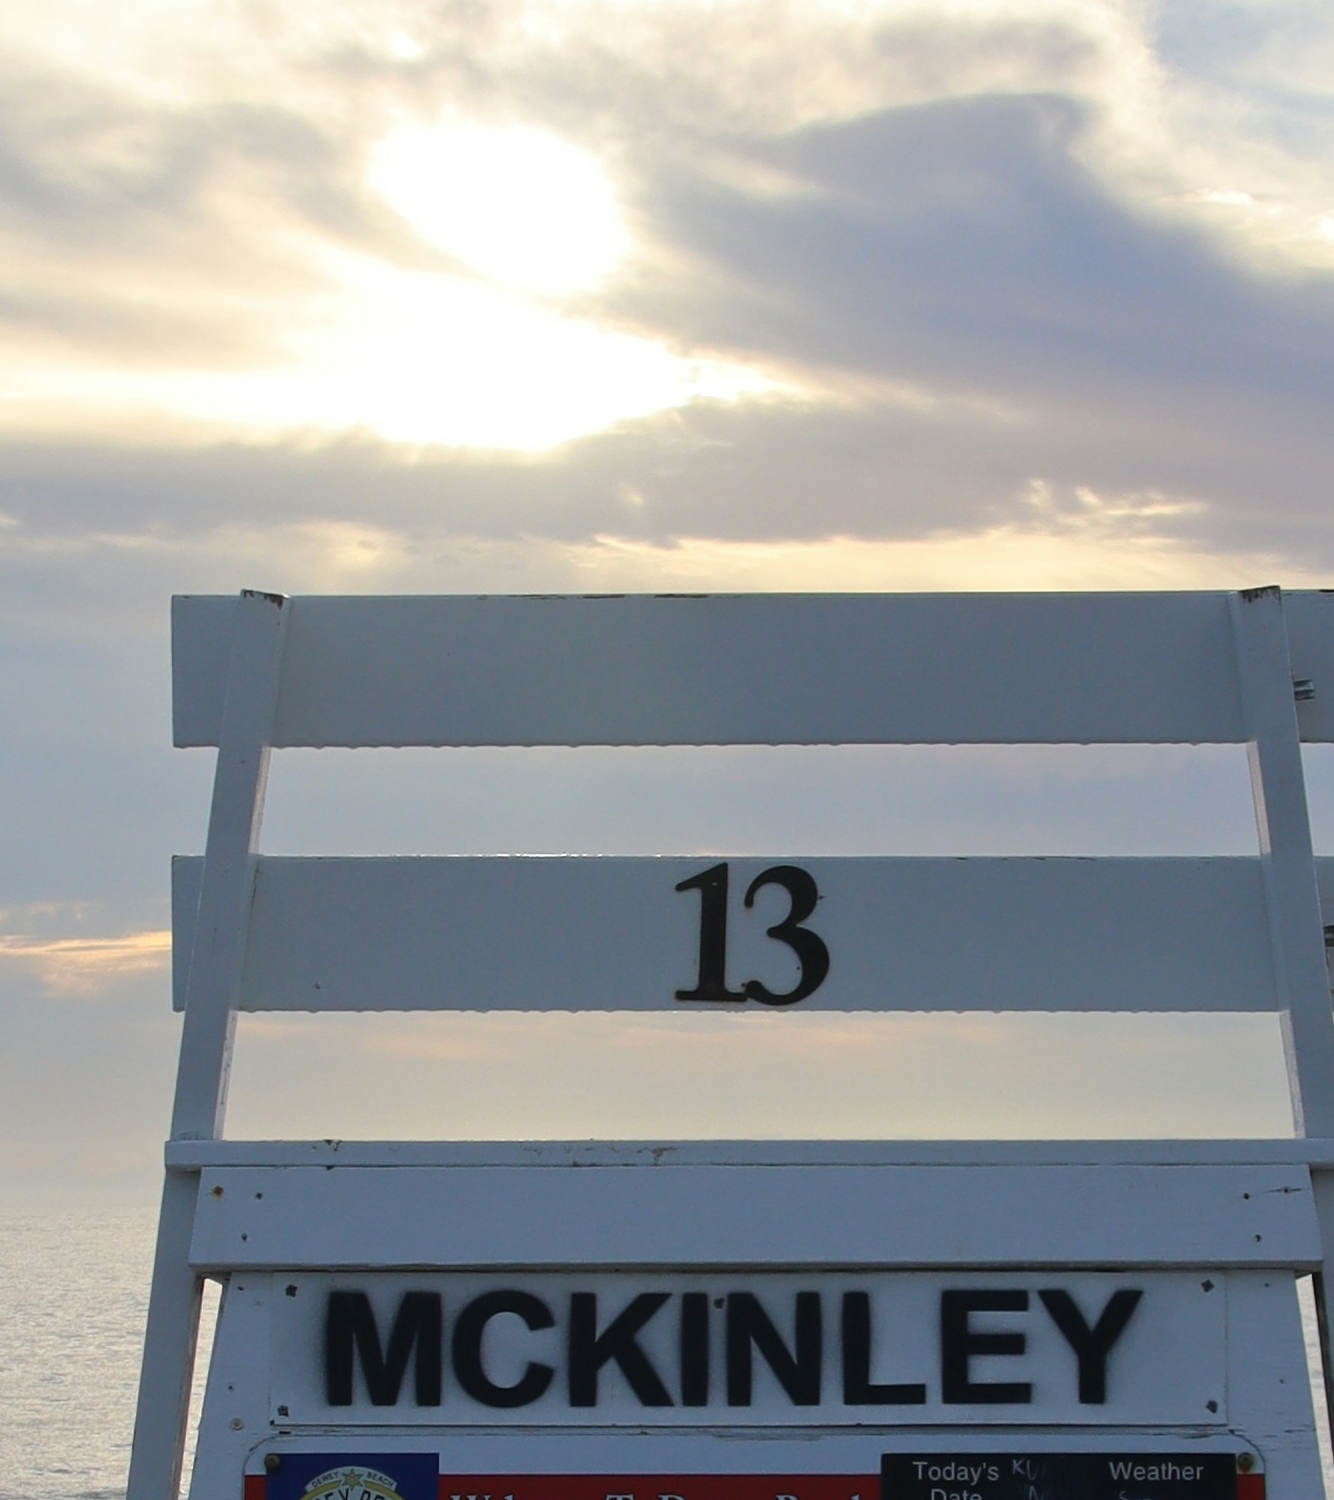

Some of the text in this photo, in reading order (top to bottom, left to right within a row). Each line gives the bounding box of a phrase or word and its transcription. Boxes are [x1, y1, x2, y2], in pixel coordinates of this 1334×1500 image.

[675, 862, 829, 1006] 13
[322, 1289, 1143, 1408] MCKINLEY
[366, 1471, 394, 1487] BEACH
[913, 1462, 999, 1485] Today's
[1109, 1462, 1203, 1480] Weather
